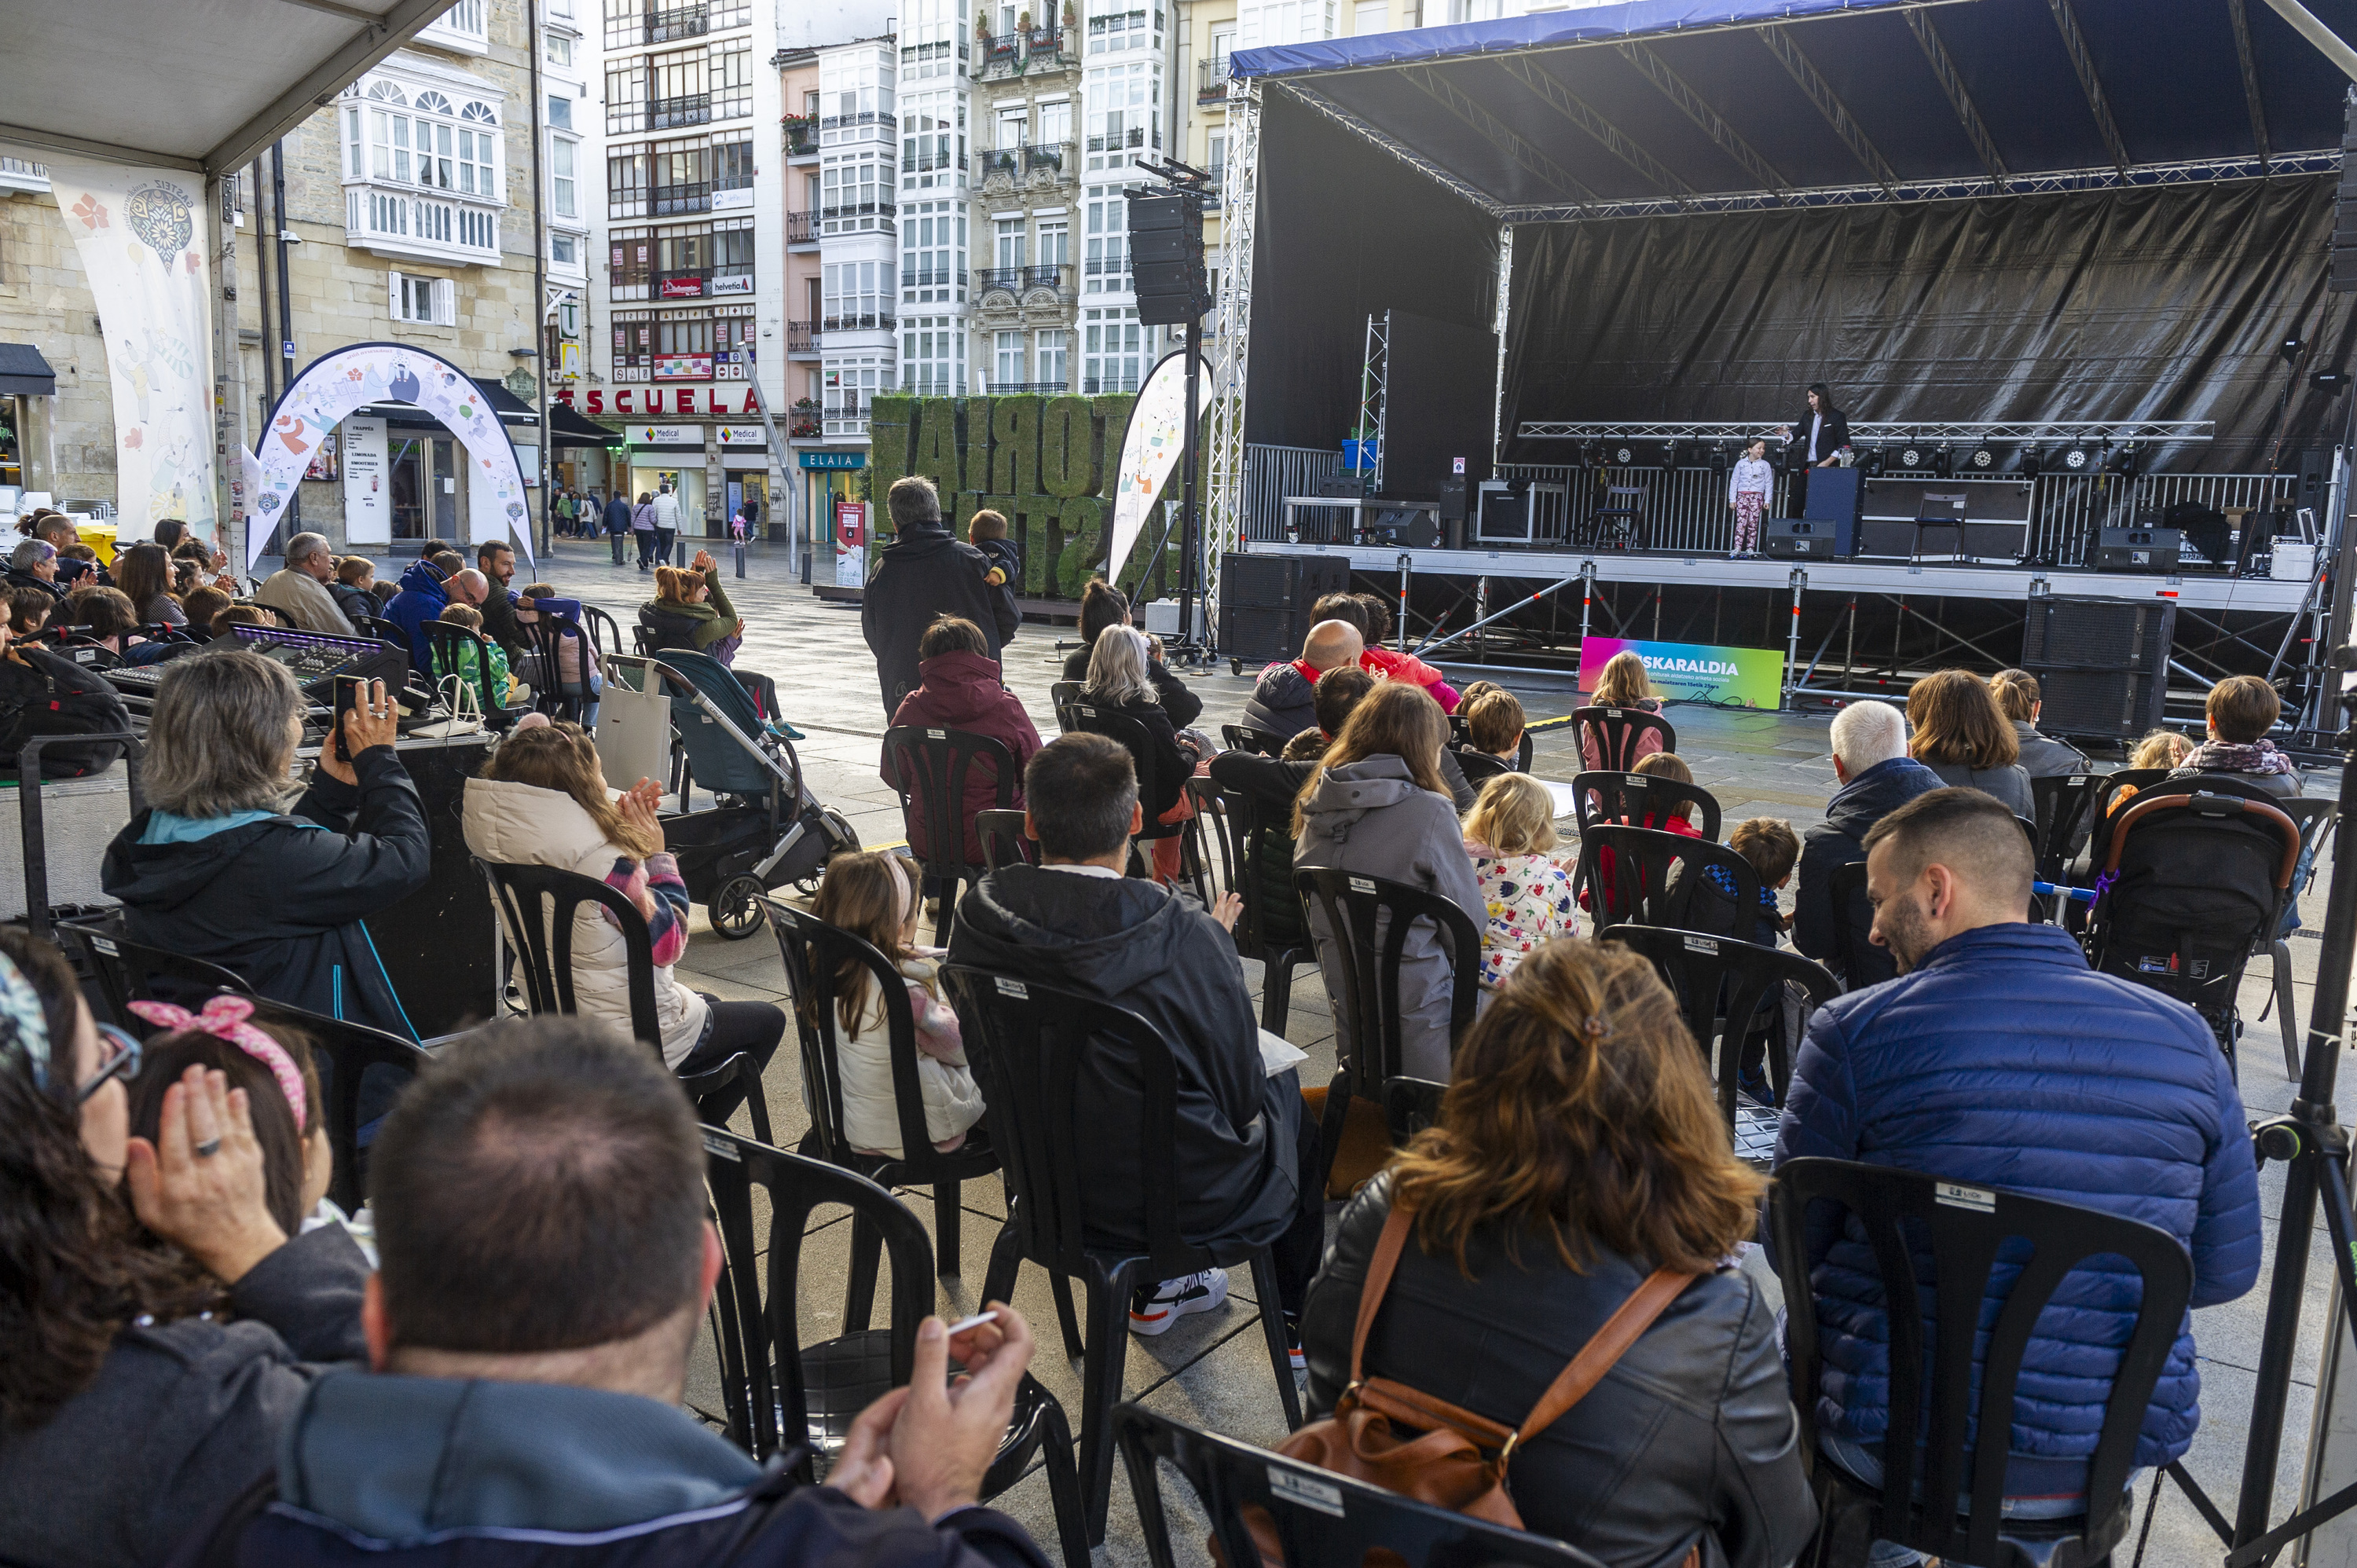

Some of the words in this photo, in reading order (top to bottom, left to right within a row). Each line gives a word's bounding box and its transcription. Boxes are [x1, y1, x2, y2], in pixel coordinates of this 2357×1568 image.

[715, 281, 740, 291] helvetia
[558, 388, 761, 414] ESCUELA
[733, 429, 757, 438] Medical
[810, 455, 852, 465] ELAIA
[1637, 655, 1739, 676] SKARALDIA
[709, 707, 723, 720] CRUZ
